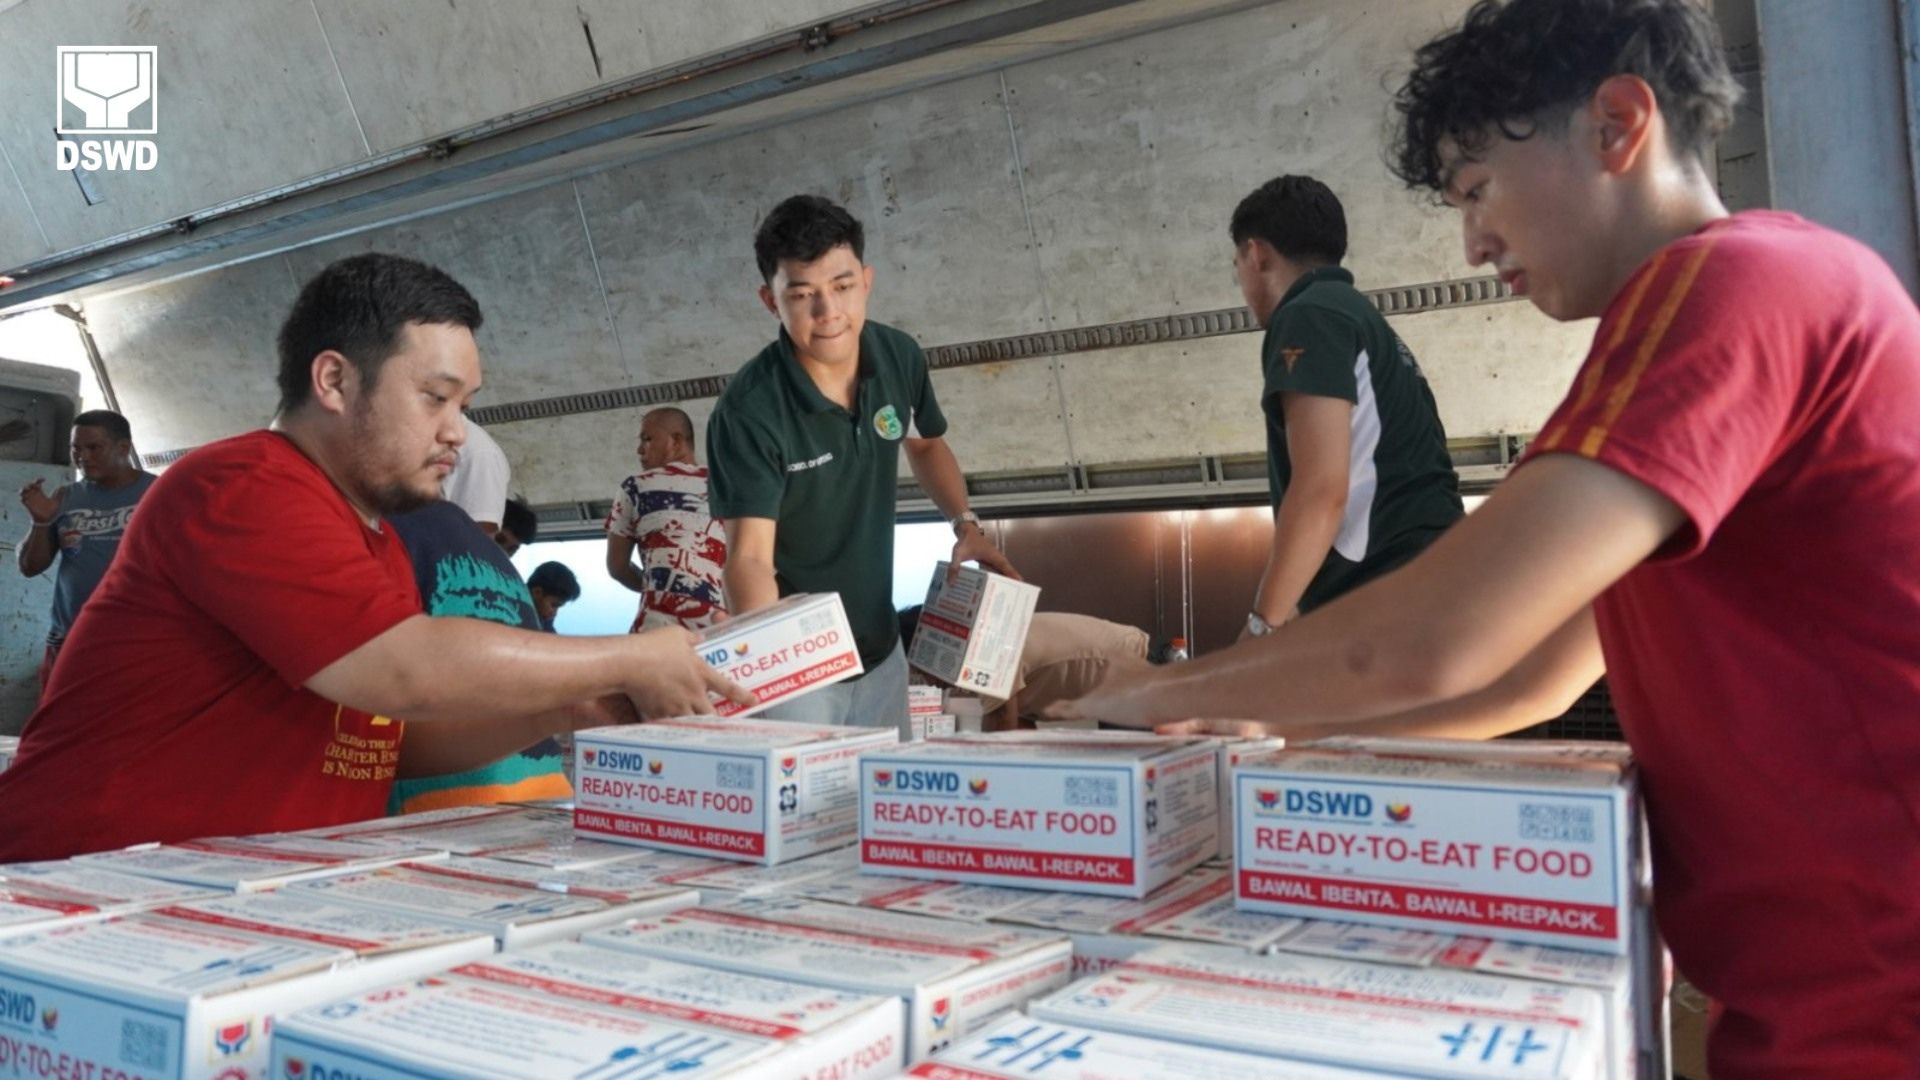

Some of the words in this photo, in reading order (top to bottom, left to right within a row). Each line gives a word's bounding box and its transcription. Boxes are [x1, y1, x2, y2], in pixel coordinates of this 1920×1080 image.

[705, 648, 728, 666] WD
[728, 649, 788, 682] -TO-EAT
[793, 630, 839, 658] FOOD
[759, 679, 799, 698] BAWAL
[598, 751, 643, 771] DSWD
[582, 777, 697, 807] READY-TO-EAT
[703, 792, 753, 814] FOOD
[897, 771, 959, 791] DSWD
[874, 802, 1038, 831] READY-TO-EAT
[1046, 812, 1117, 835] FOOD
[1286, 790, 1372, 817] DSWD
[577, 813, 612, 829] BAWAL
[615, 819, 654, 835] IBENTA.
[658, 826, 696, 843] BAWAL
[700, 832, 757, 850] I-REPACK.
[869, 845, 917, 862] BAWAL
[923, 849, 979, 868] IBENTA.
[984, 853, 1038, 871] BAWAL
[1041, 860, 1125, 879] I-REPACK.
[1256, 827, 1482, 869] READY-TO-EAT
[1494, 847, 1593, 878] FOOD
[1249, 877, 1314, 901] BAWAL
[1322, 884, 1400, 910] IBENTA.
[1406, 893, 1484, 919] BAWAL
[1489, 903, 1604, 931] I-REPACK.
[0, 988, 36, 1023] SWD
[0, 1036, 95, 1080] DY-TO-EAT
[853, 1034, 893, 1073] FOOD
